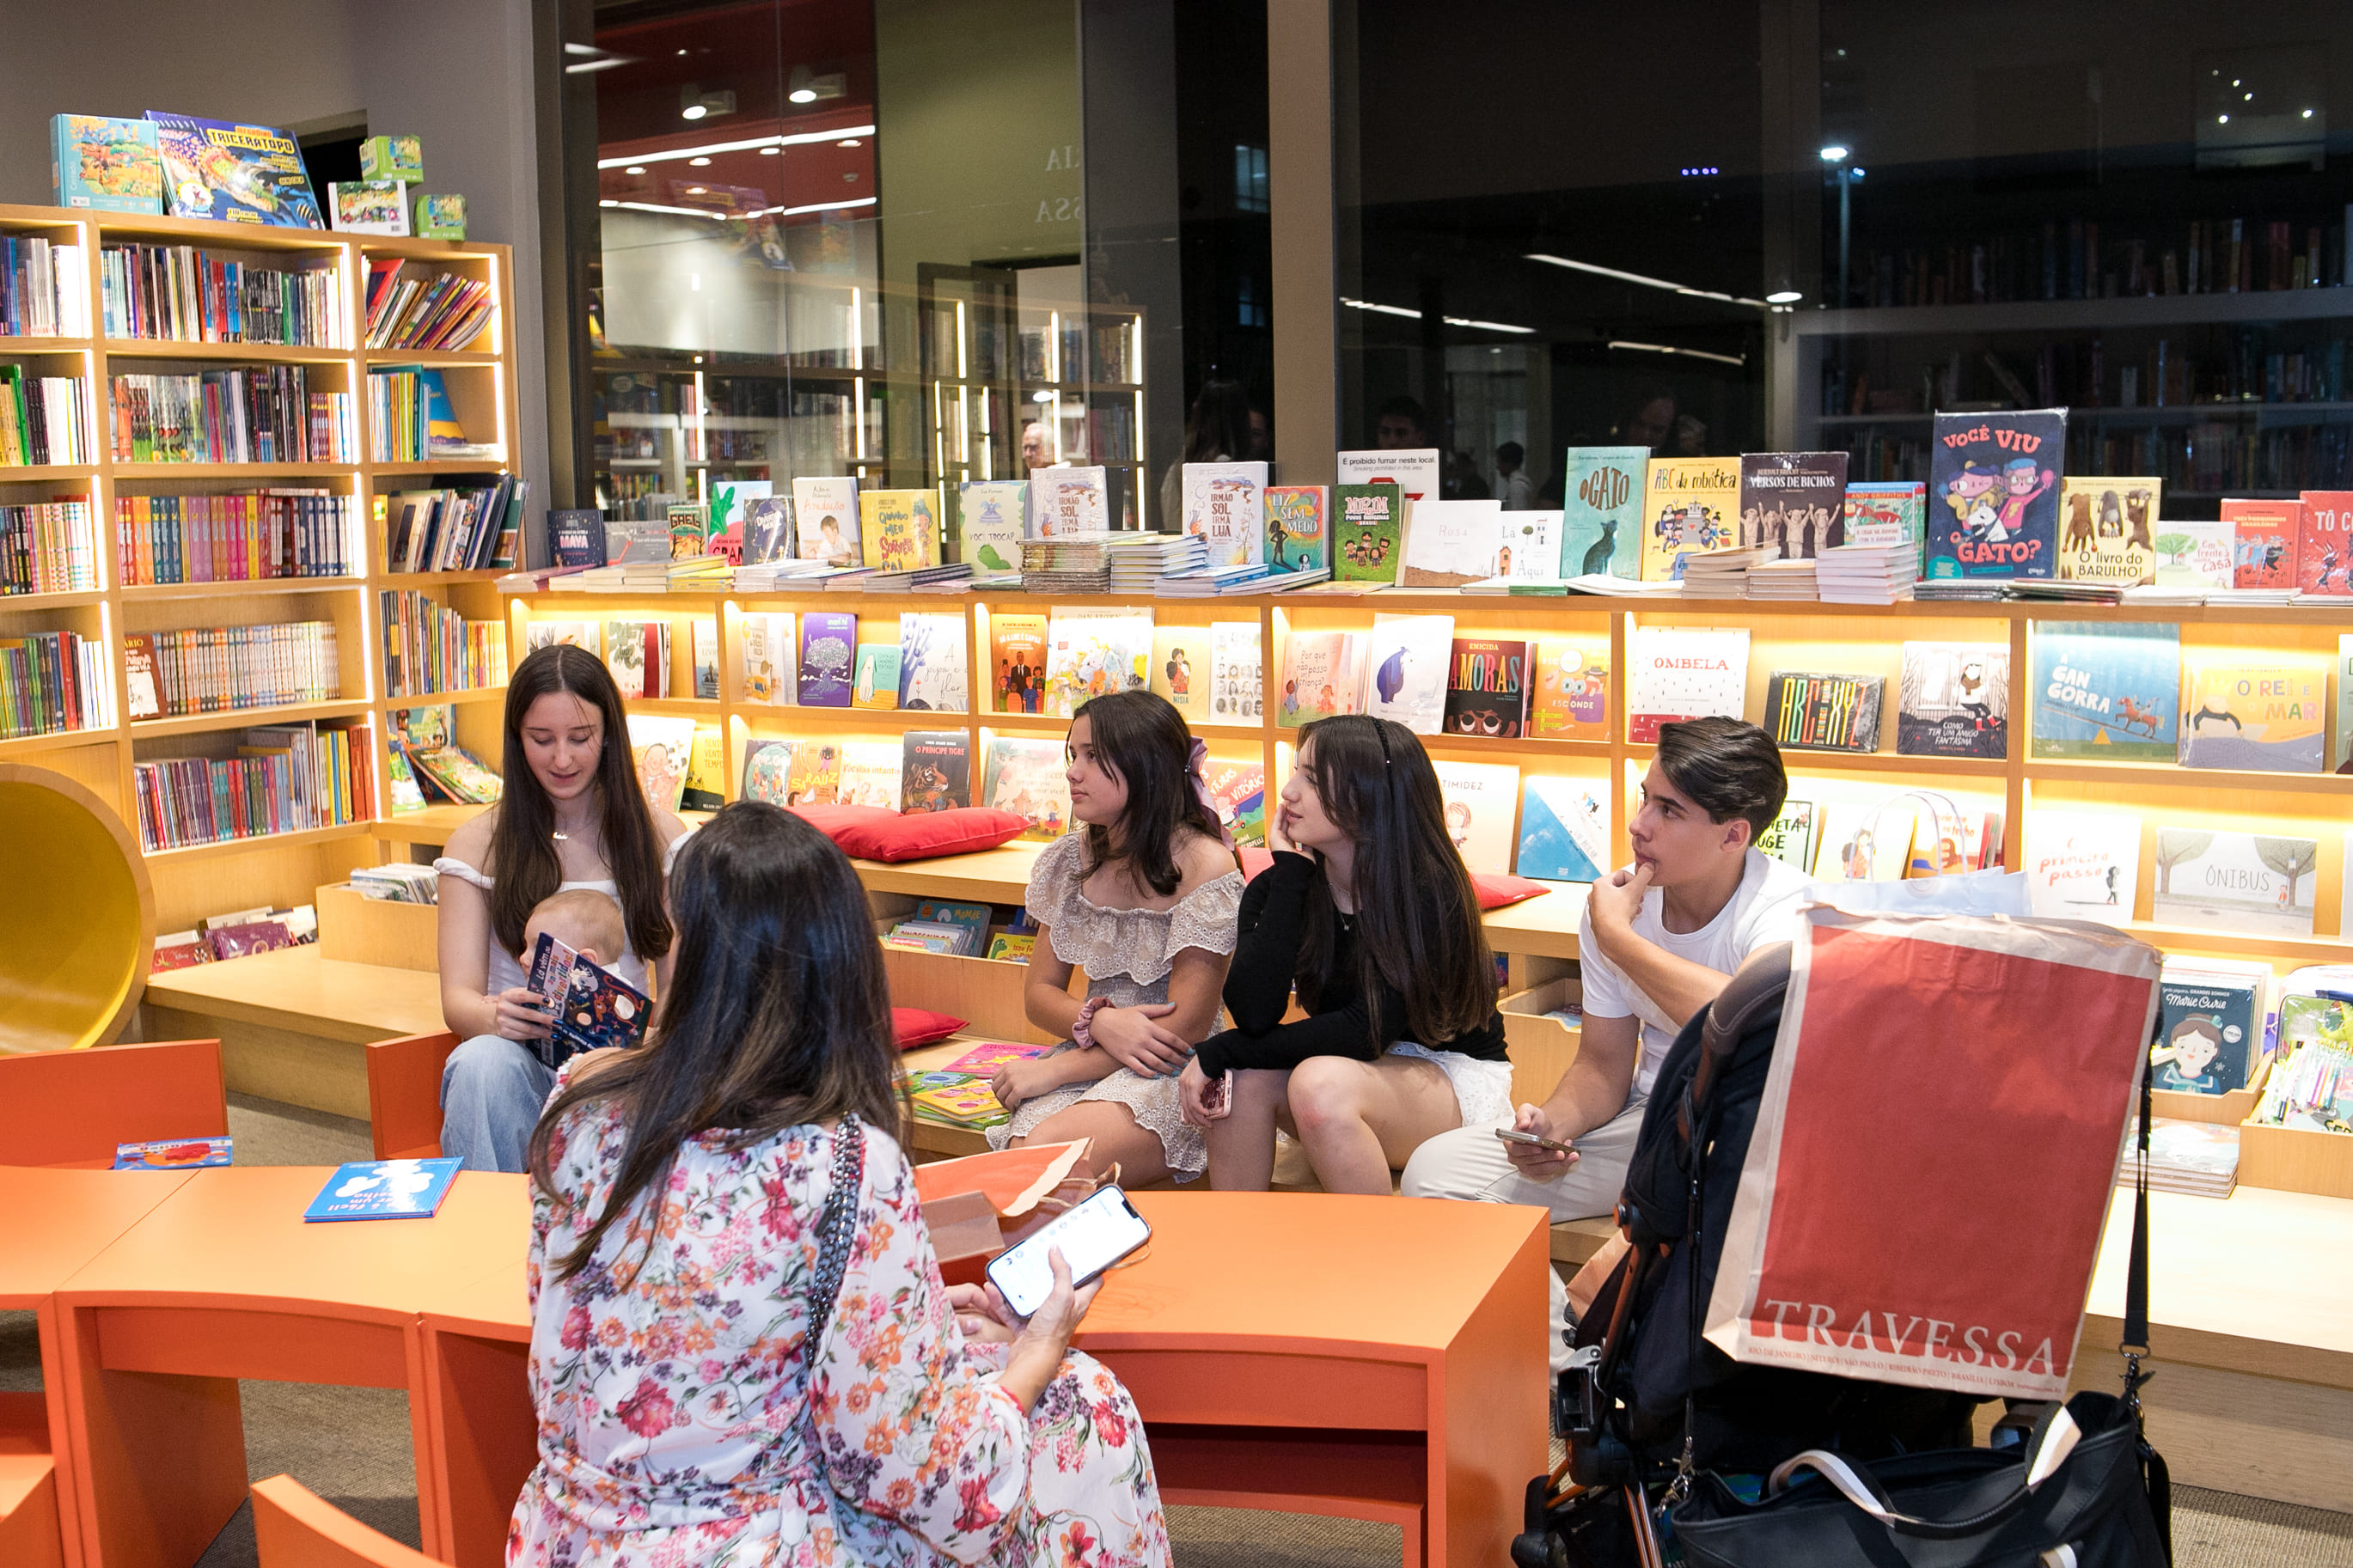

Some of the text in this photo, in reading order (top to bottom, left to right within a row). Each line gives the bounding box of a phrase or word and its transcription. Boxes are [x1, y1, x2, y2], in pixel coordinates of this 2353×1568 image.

[208, 130, 294, 153] TRICERATOPO
[1943, 424, 2042, 454] VOCÊ VIU
[1349, 458, 1376, 467] proibido
[1654, 468, 1736, 490] ABC da robótica
[1750, 475, 1836, 488] VERSOS DE BICHOS
[1588, 466, 1629, 511] GATO
[1210, 491, 1234, 503] IRMÃO
[1273, 494, 1291, 506] LIZ
[1280, 507, 1305, 520] SEM
[1345, 497, 1389, 516] MIRIM
[670, 514, 701, 530] GAEL
[1287, 521, 1318, 533] MEDO
[2314, 509, 2353, 531] TÔ C
[969, 533, 986, 541] VOC
[1212, 525, 1232, 537] LUA
[1950, 531, 1961, 544] O
[559, 534, 589, 548] MAYA
[1957, 539, 2042, 564] GATO?
[2079, 551, 2142, 564] O livro do
[2078, 564, 2142, 577] BARULHO!
[2202, 558, 2232, 572] casa
[1300, 650, 1327, 661] Por que
[1296, 662, 1308, 672] não
[1654, 657, 1729, 670] OMBELA
[924, 664, 949, 682] pipa
[1449, 653, 1521, 693] AMORAS
[2051, 665, 2092, 689] GAN
[939, 673, 962, 699] flor
[1298, 677, 1325, 690] criança?
[2237, 680, 2251, 696] O
[1173, 693, 1189, 704] NÍSIA
[1552, 700, 1594, 709] ESCONDE
[2046, 682, 2111, 714] GORRA
[1776, 678, 1821, 743] ABC
[2264, 702, 2318, 720] MAR
[1956, 729, 1978, 737] AMIGO
[1934, 736, 1972, 746] FANTASMA
[921, 746, 948, 754] PRÍNCIPE
[1210, 768, 1237, 795] NTURAS
[1231, 773, 1264, 801] VITÓRIO
[1442, 779, 1484, 790] TIMIDEZ
[1757, 834, 1787, 849] UGE
[2049, 868, 2102, 887] passo
[553, 949, 573, 1001] divertidos!
[2166, 994, 2228, 1010] Marie Curie
[327, 1203, 365, 1211] fácil
[1763, 1298, 2061, 1376] TRAVESSA
[1748, 1346, 1762, 1355] RIO
[1775, 1350, 1806, 1360] JANEIRO
[1843, 1357, 1858, 1366] SÃO
[1859, 1360, 1885, 1370] PAULO
[1922, 1368, 1947, 1377] PRETO
[1951, 1373, 1984, 1383] BRASÍLIA
[1989, 1378, 2014, 1388] LISBOA
